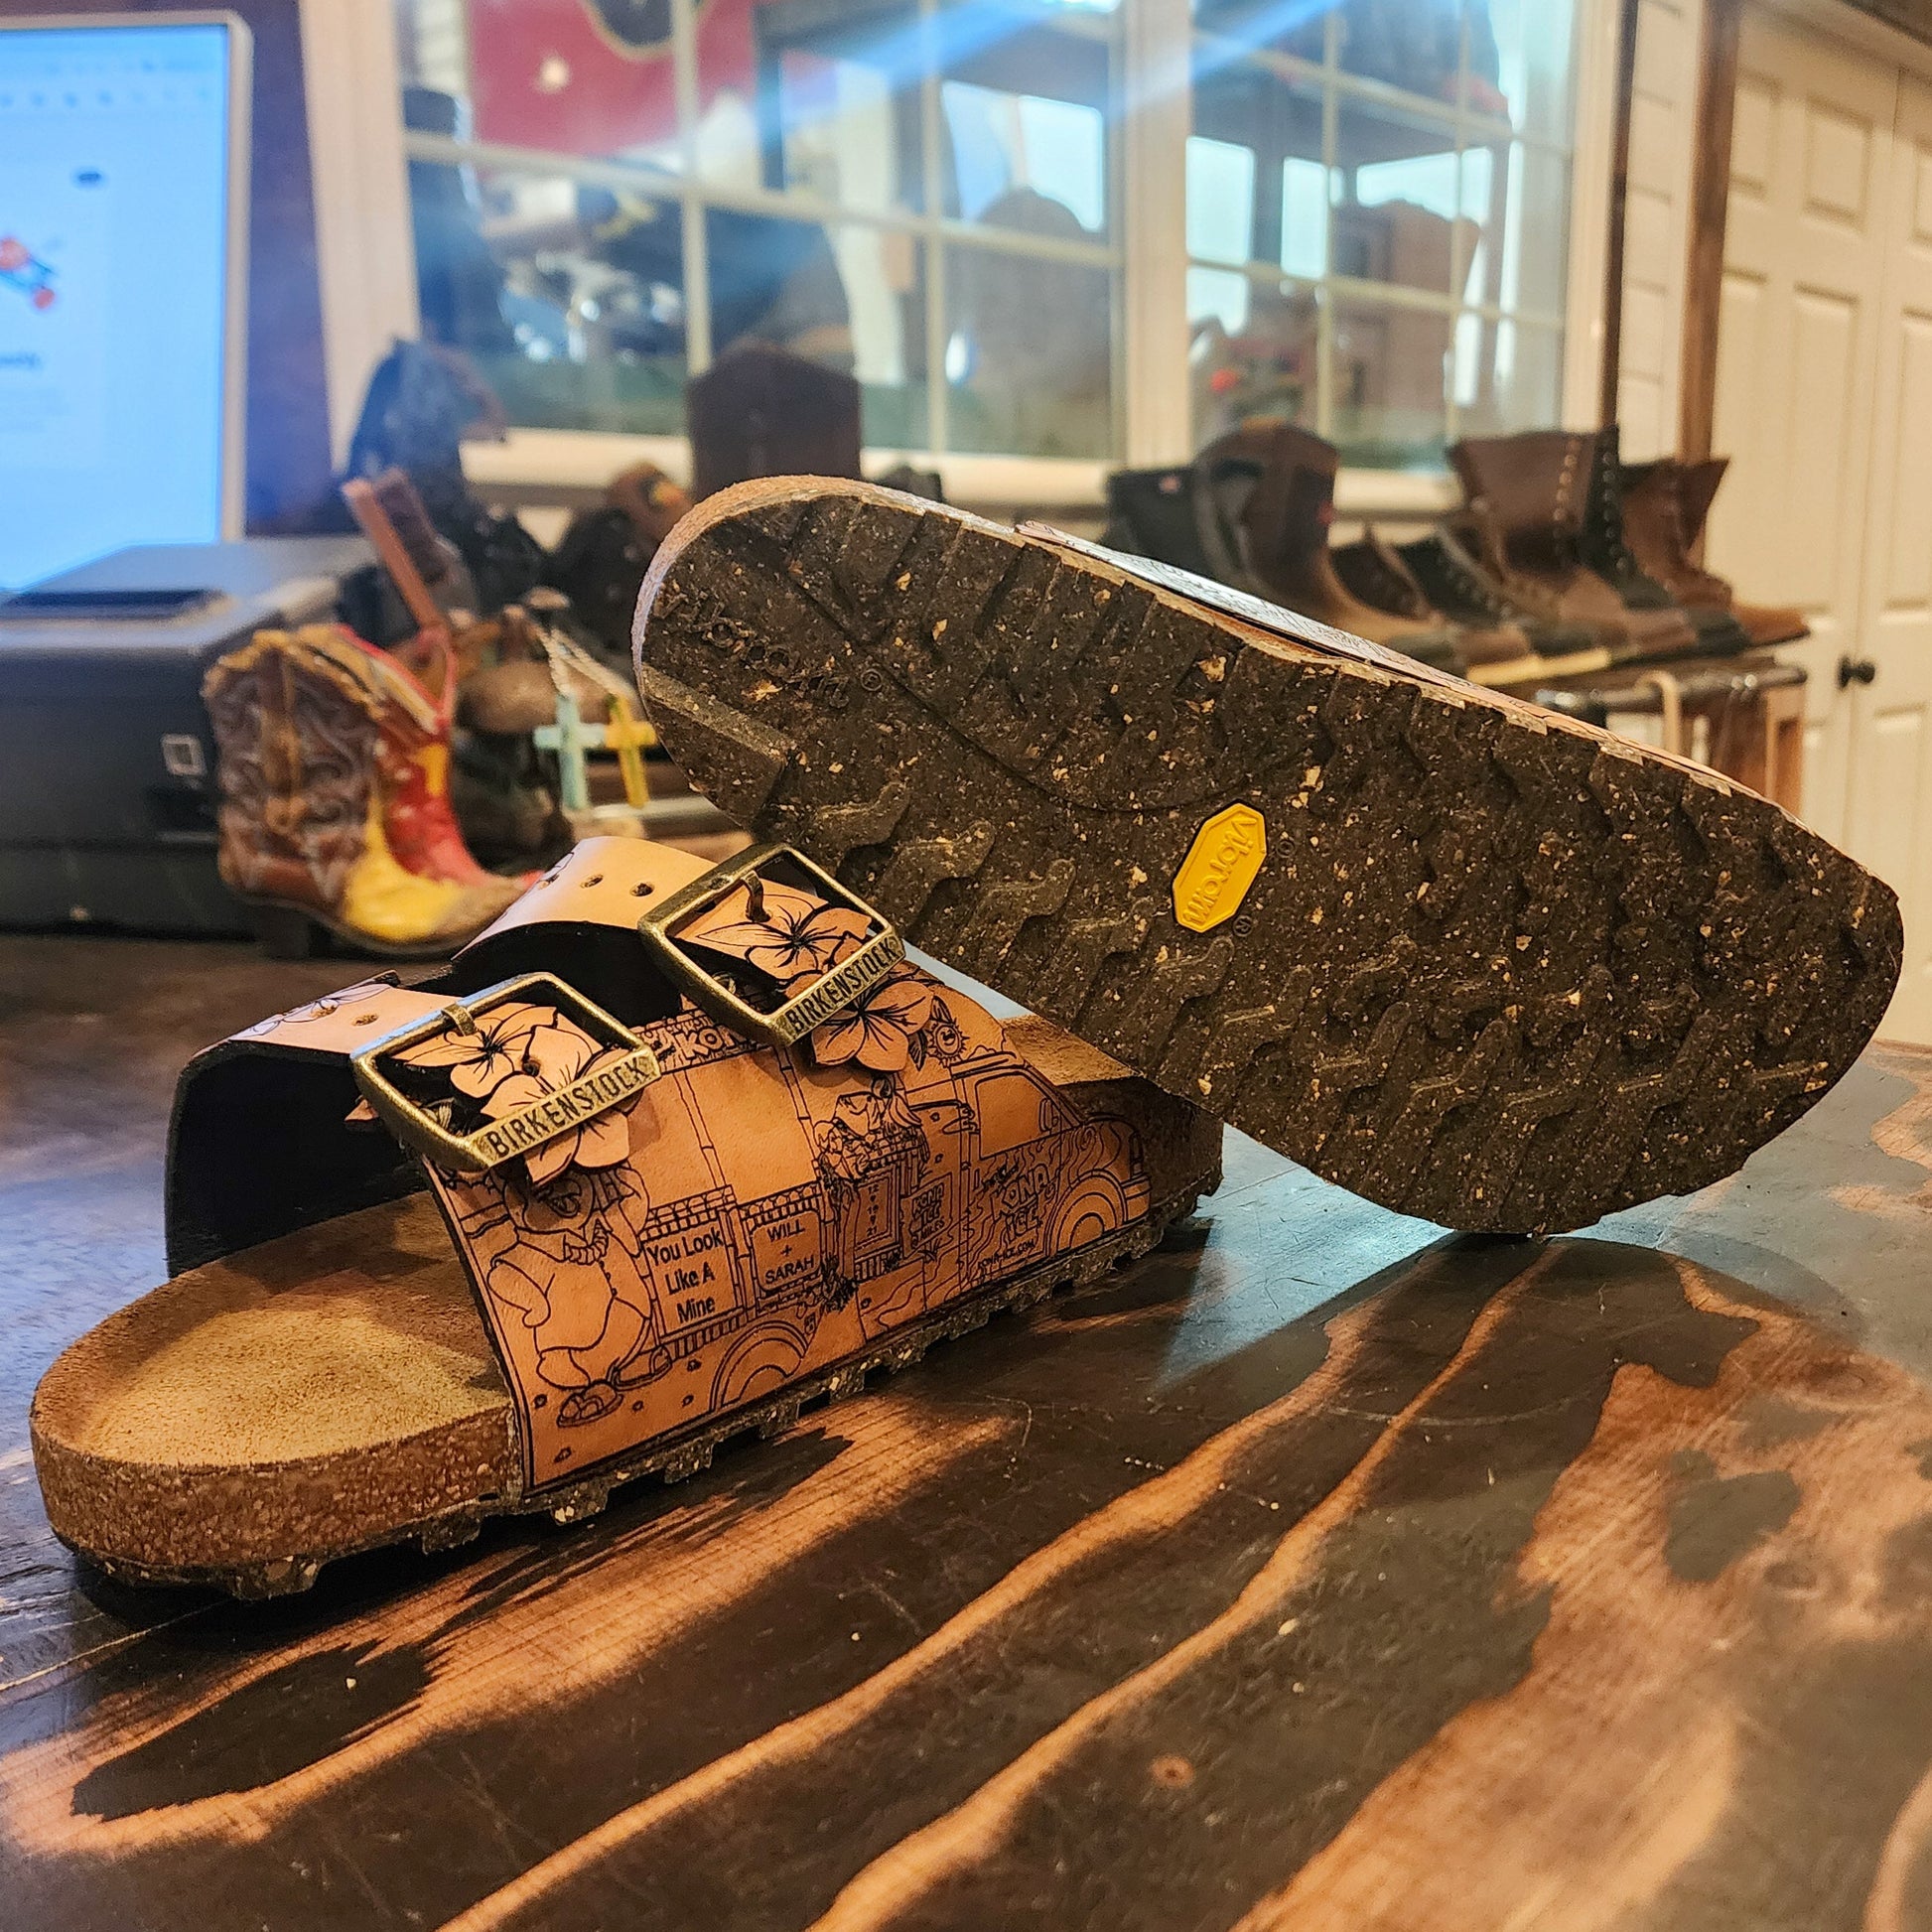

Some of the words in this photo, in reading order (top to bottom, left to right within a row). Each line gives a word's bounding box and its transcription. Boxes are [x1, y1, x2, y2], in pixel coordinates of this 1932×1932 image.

[784, 936, 900, 1034] BIRKENSTOCK
[485, 1056, 649, 1159] BIRKENSTOCK
[646, 1243, 682, 1267] You
[681, 1226, 724, 1258] Look
[766, 1218, 807, 1243] WILL
[664, 1268, 701, 1296] Like
[702, 1261, 717, 1285] A
[764, 1253, 815, 1285] SARAH
[676, 1296, 717, 1324] Mine
